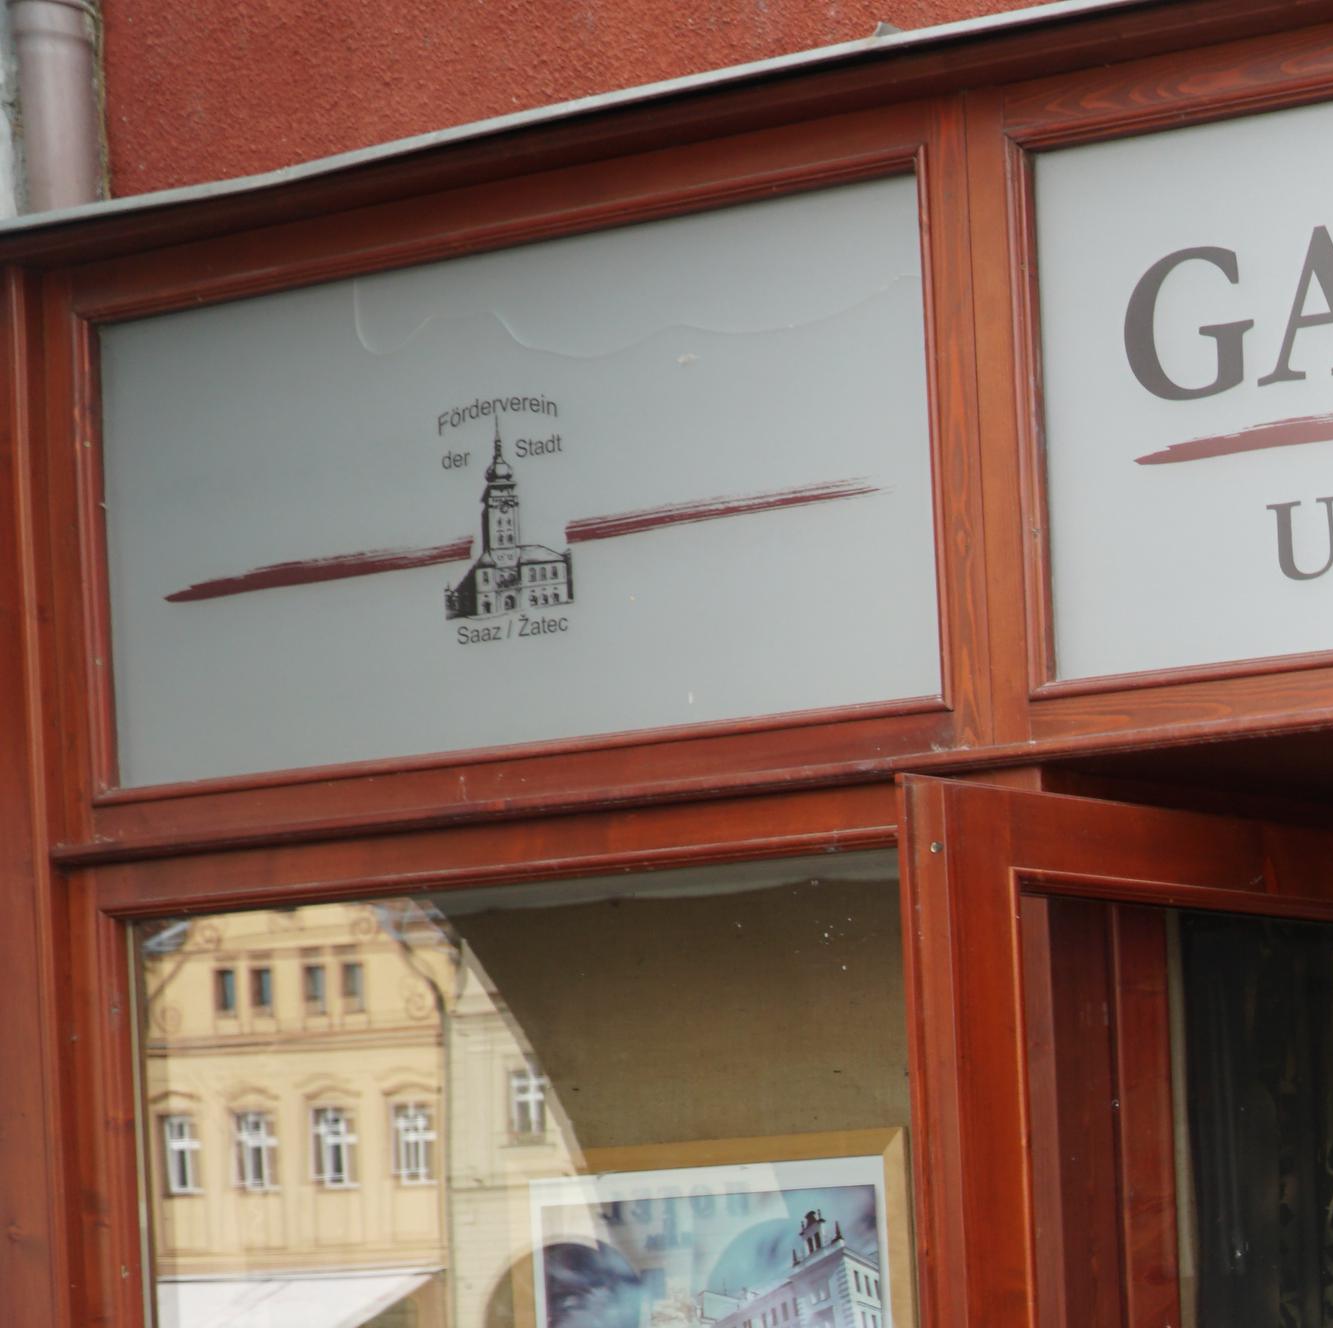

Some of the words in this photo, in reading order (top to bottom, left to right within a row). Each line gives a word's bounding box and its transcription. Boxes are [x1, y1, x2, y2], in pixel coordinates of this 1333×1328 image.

[437, 393, 558, 436] Förderverein
[441, 449, 471, 471] der
[515, 433, 563, 459] Stadt
[456, 623, 503, 646] Saaz
[517, 612, 569, 639] Žatec
